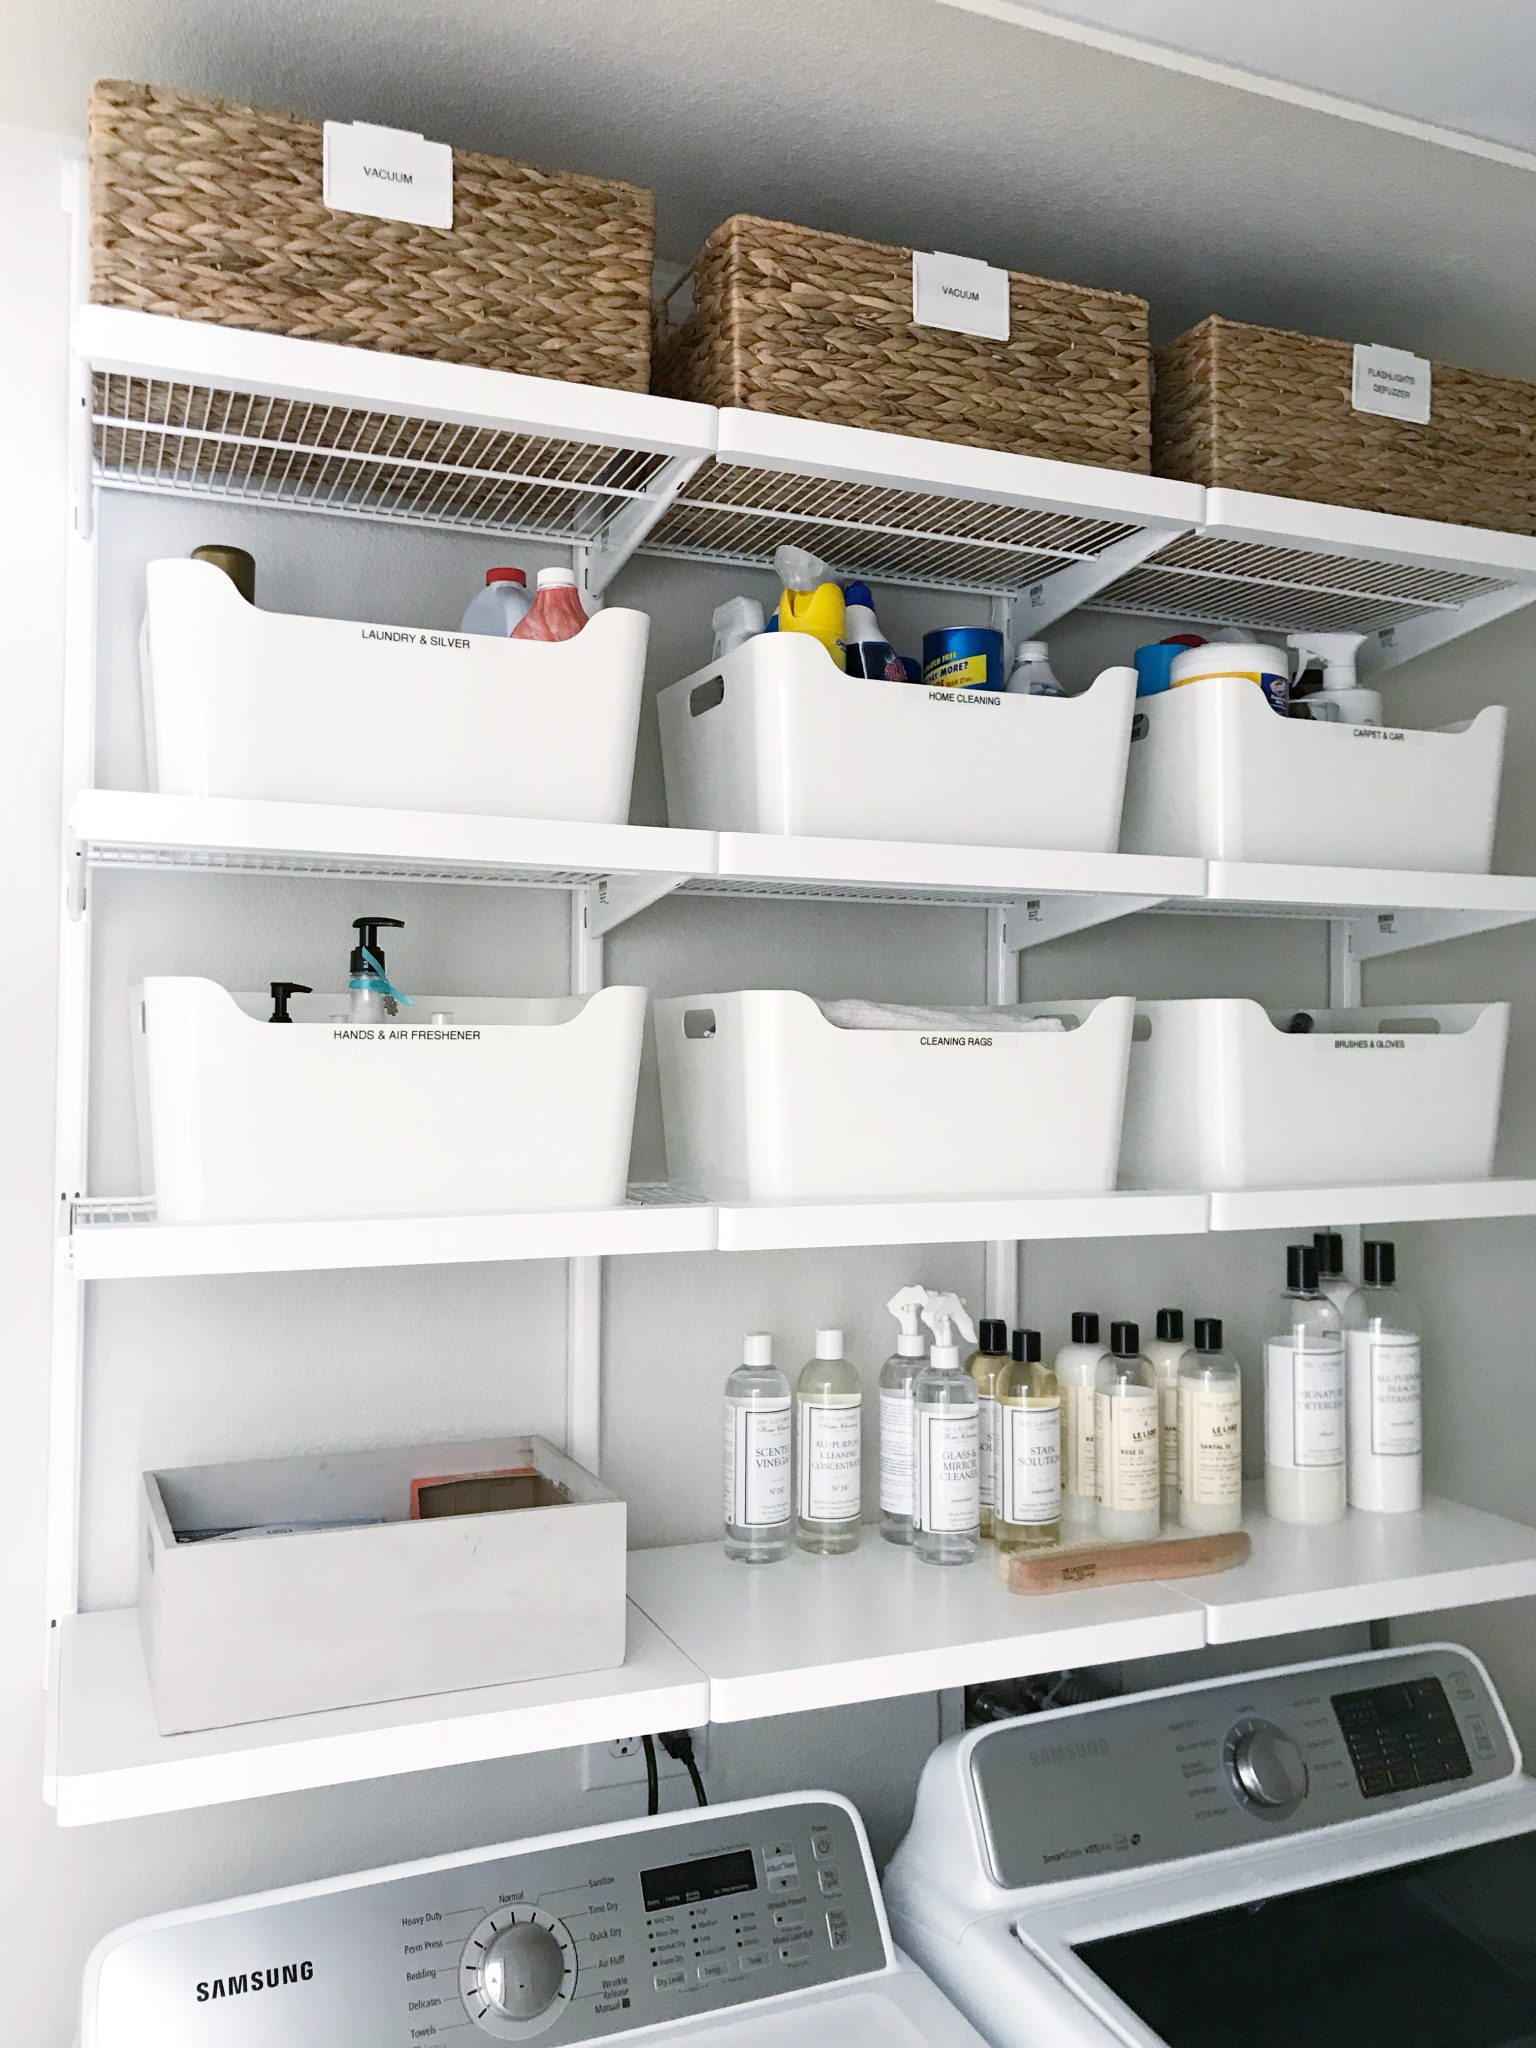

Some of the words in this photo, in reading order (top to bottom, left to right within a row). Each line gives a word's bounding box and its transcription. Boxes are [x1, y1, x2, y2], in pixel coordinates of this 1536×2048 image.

[364, 166, 413, 184] VACUUM
[942, 285, 979, 301] VACUUM
[362, 629, 416, 643] LAUNDRY
[419, 635, 428, 645] &
[430, 636, 471, 649] SILVER
[940, 661, 969, 677] MORE?
[928, 691, 955, 702] HOME
[957, 694, 1001, 706] CLEANING
[1353, 729, 1381, 739] CARPET
[1383, 732, 1388, 740] &
[1389, 732, 1404, 741] CAR
[333, 1030, 375, 1040] HANDS
[377, 1030, 386, 1040] &
[388, 1030, 408, 1040] AIR
[411, 1030, 481, 1040] FRESHENER
[920, 1036, 966, 1046] CLEANING
[968, 1037, 993, 1046] RAGS
[1334, 1040, 1368, 1048] BRUSHES
[1369, 1040, 1375, 1048] &
[1376, 1040, 1405, 1048] GLOVES
[755, 1444, 789, 1457] SCENTE
[820, 1450, 857, 1459] CLEANIN
[1030, 1445, 1055, 1455] STAIN
[756, 1457, 789, 1468] VINEGA
[811, 1461, 859, 1470] CONCENTRA
[940, 1470, 977, 1480] CLEANE
[1029, 1739, 1110, 1767] SAMSUNG
[588, 1876, 615, 1888] Sanitize
[499, 1891, 524, 1903] Normal
[588, 1904, 605, 1915] Time
[606, 1902, 619, 1913] Dry
[401, 1914, 425, 1927] Heavy
[426, 1911, 443, 1922] Duty
[589, 1929, 607, 1942] Quick
[608, 1926, 622, 1938] Dry
[404, 1942, 422, 1954] Perm
[423, 1938, 444, 1950] Press
[610, 1955, 626, 1966] Fluff
[406, 1968, 436, 1982] Bedding
[601, 1976, 629, 1990] Wrinkle
[656, 1979, 668, 1989] Dry
[602, 1987, 630, 2000] Release
[408, 1998, 442, 2011] Delicates
[594, 2001, 621, 2014] Manual
[410, 2025, 437, 2039] Towels
